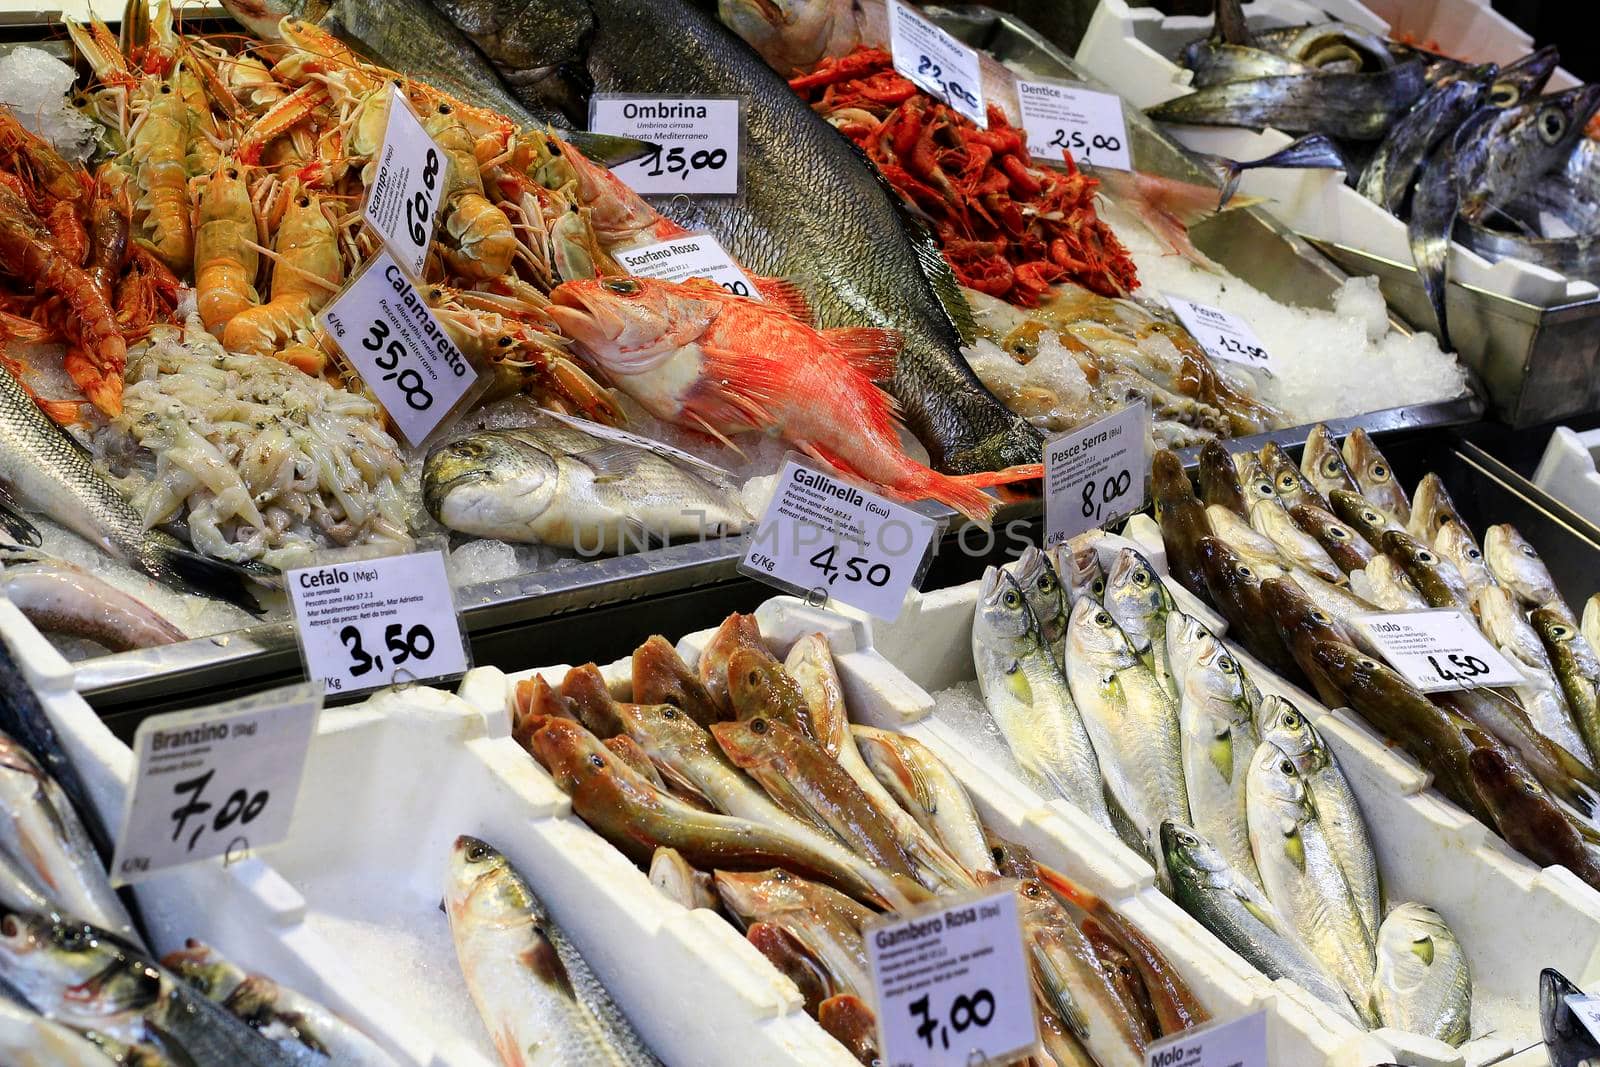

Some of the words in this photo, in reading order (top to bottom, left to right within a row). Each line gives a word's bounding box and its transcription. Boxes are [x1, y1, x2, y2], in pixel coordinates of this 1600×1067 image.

[1021, 83, 1060, 98] Dentice
[623, 102, 707, 119] Ombrina
[654, 132, 708, 140] Mediterraneo
[1049, 129, 1120, 156] 25,00
[639, 144, 727, 180] 15,00
[369, 167, 388, 219] Scampo
[406, 148, 439, 247] 60,00
[625, 249, 672, 267] Scorfano
[671, 242, 700, 256] Rosso
[327, 312, 346, 338] €/Kg
[385, 264, 466, 377] Calamaretto
[379, 299, 402, 330] Pescato
[399, 327, 438, 381] Mediterraneo
[362, 319, 433, 411] 35,00
[1051, 445, 1080, 465] Pesce
[1082, 431, 1107, 451] Serra
[782, 498, 794, 508] Mar
[785, 490, 807, 503] Pescato
[807, 499, 822, 510] zona
[793, 468, 864, 507] Gallinella
[865, 501, 890, 519] (Guu)
[1082, 469, 1131, 520] 8,00
[777, 507, 800, 520] Attrezzi
[751, 553, 775, 572] €/Kg
[810, 545, 891, 587] 4,50
[300, 568, 349, 588] Cefalo
[353, 569, 378, 583] (Mgc)
[305, 599, 327, 608] Pescato
[343, 594, 355, 603] FAO
[307, 609, 320, 617] Mar
[321, 604, 360, 615] Mediterraneo
[361, 601, 386, 610] Centrale,
[386, 598, 399, 606] Mar
[399, 595, 424, 604] Adriatico
[309, 618, 332, 627] Attrezzi
[371, 610, 380, 618] da
[380, 609, 397, 617] traino
[1371, 622, 1400, 633] Molo
[340, 624, 435, 677] 3,50
[152, 722, 229, 751] Branzino
[172, 769, 269, 852] 7,00
[875, 918, 943, 949] Gambero
[944, 908, 977, 929] Rosa
[909, 987, 996, 1050] 7,00
[1151, 1046, 1184, 1067] Molo
